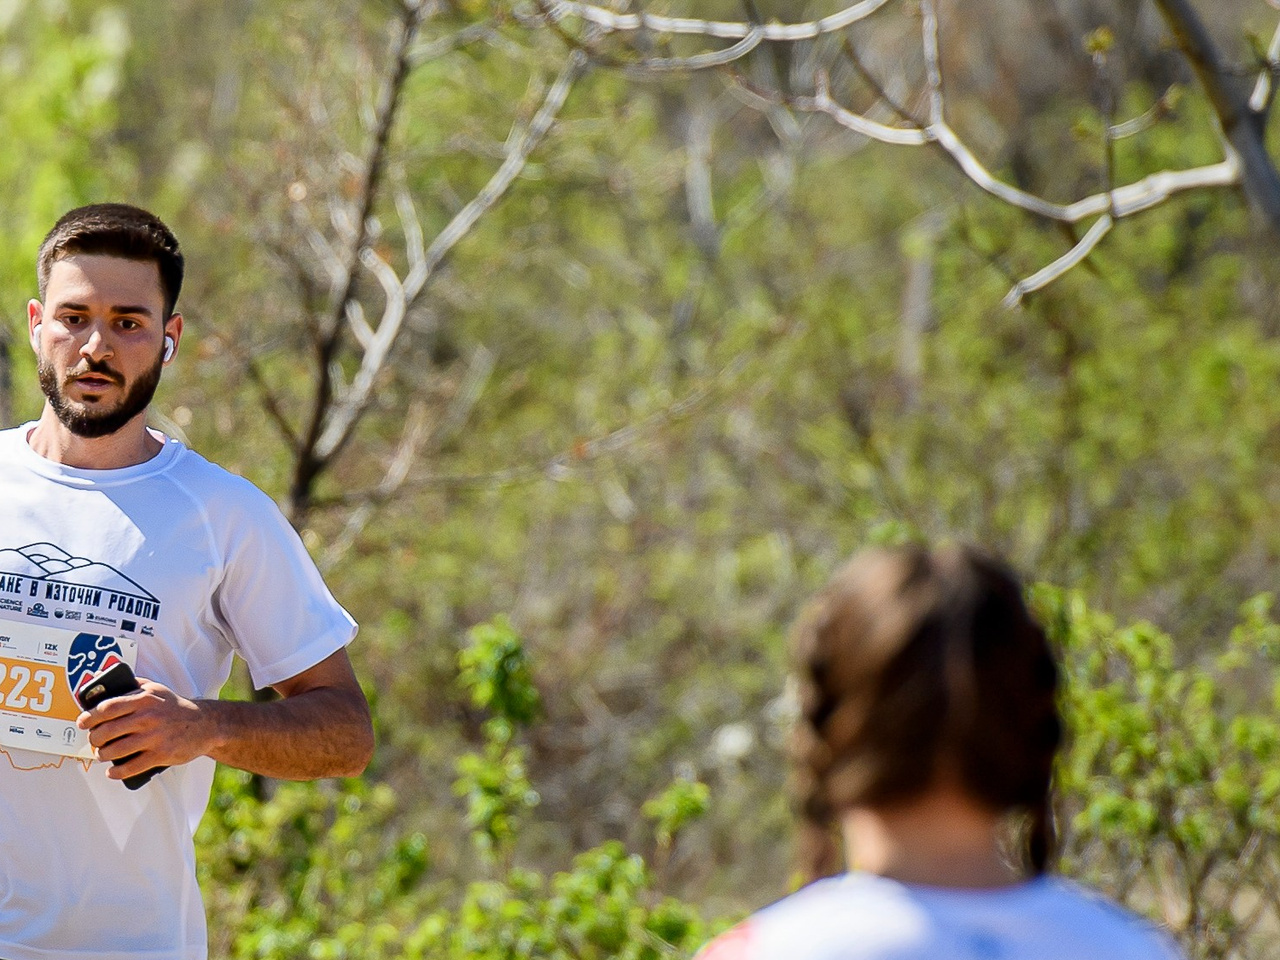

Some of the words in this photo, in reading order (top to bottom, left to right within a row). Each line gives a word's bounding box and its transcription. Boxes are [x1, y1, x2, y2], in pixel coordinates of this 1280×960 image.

[29, 580, 38, 597] В
[45, 583, 102, 607] ИЗТОЧНИ
[108, 593, 161, 621] РОДОПИ
[44, 643, 59, 652] 12K
